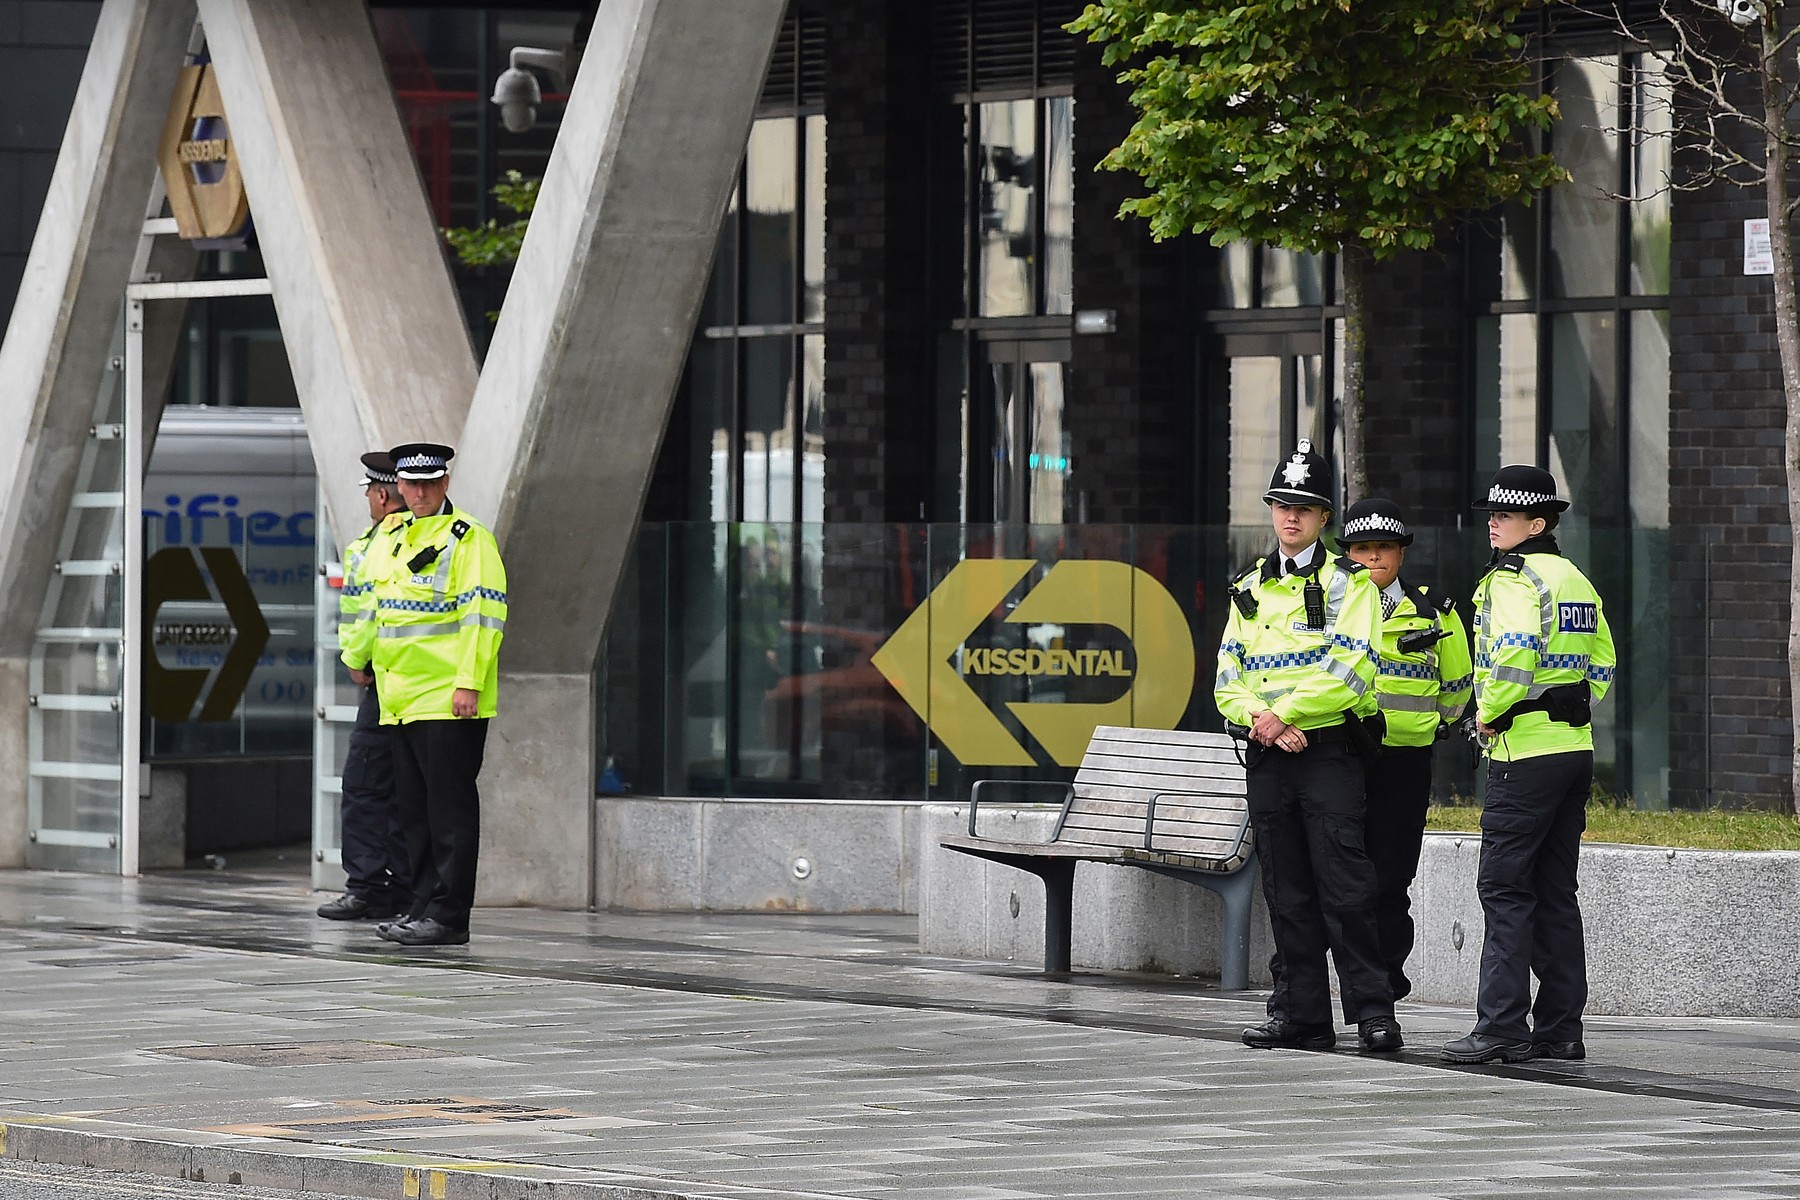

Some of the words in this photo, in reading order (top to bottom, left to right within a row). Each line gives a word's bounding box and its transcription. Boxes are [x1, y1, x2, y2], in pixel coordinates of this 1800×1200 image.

[411, 575, 433, 584] POLE
[1294, 623, 1323, 631] POL
[963, 648, 1132, 676] KISSDENTAL
